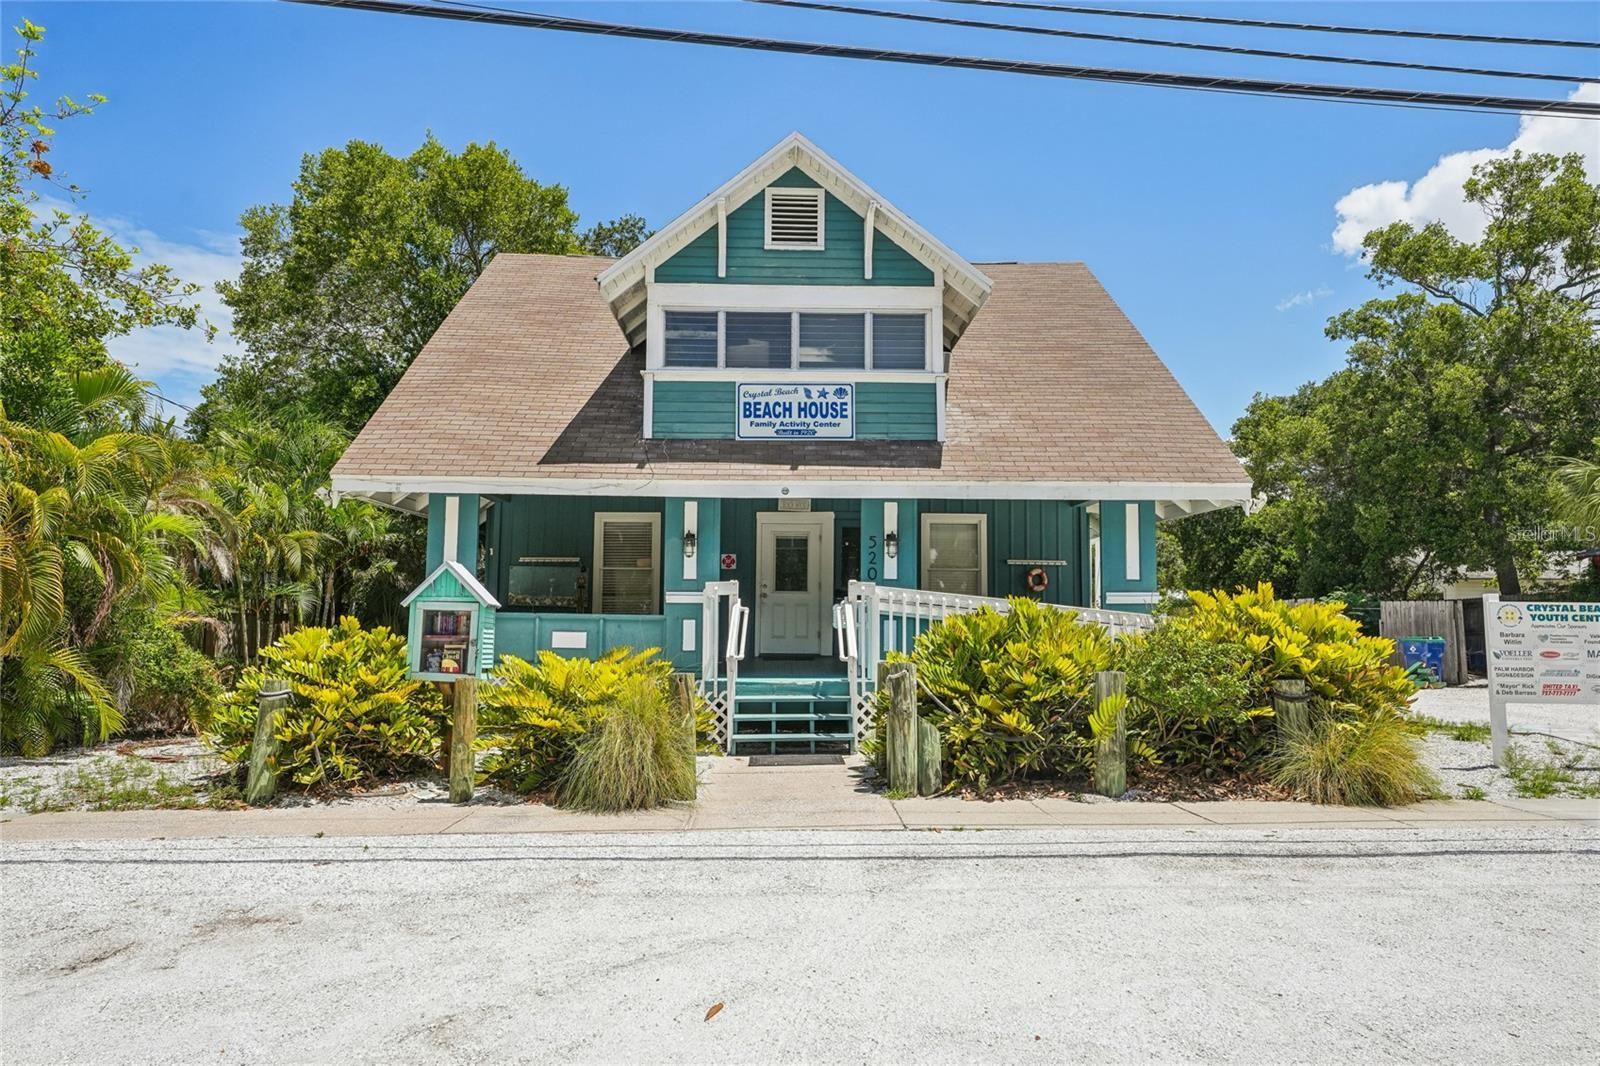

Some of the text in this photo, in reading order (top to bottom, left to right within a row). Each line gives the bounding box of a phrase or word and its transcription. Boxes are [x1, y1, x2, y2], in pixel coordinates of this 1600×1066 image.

[743, 387, 799, 400] Crystal Beach
[743, 401, 848, 419] BEACH HOUSE
[749, 420, 841, 429] Family Activity Center
[1526, 604, 1577, 612] CRYSTAL
[1530, 614, 1569, 622] YOUTH
